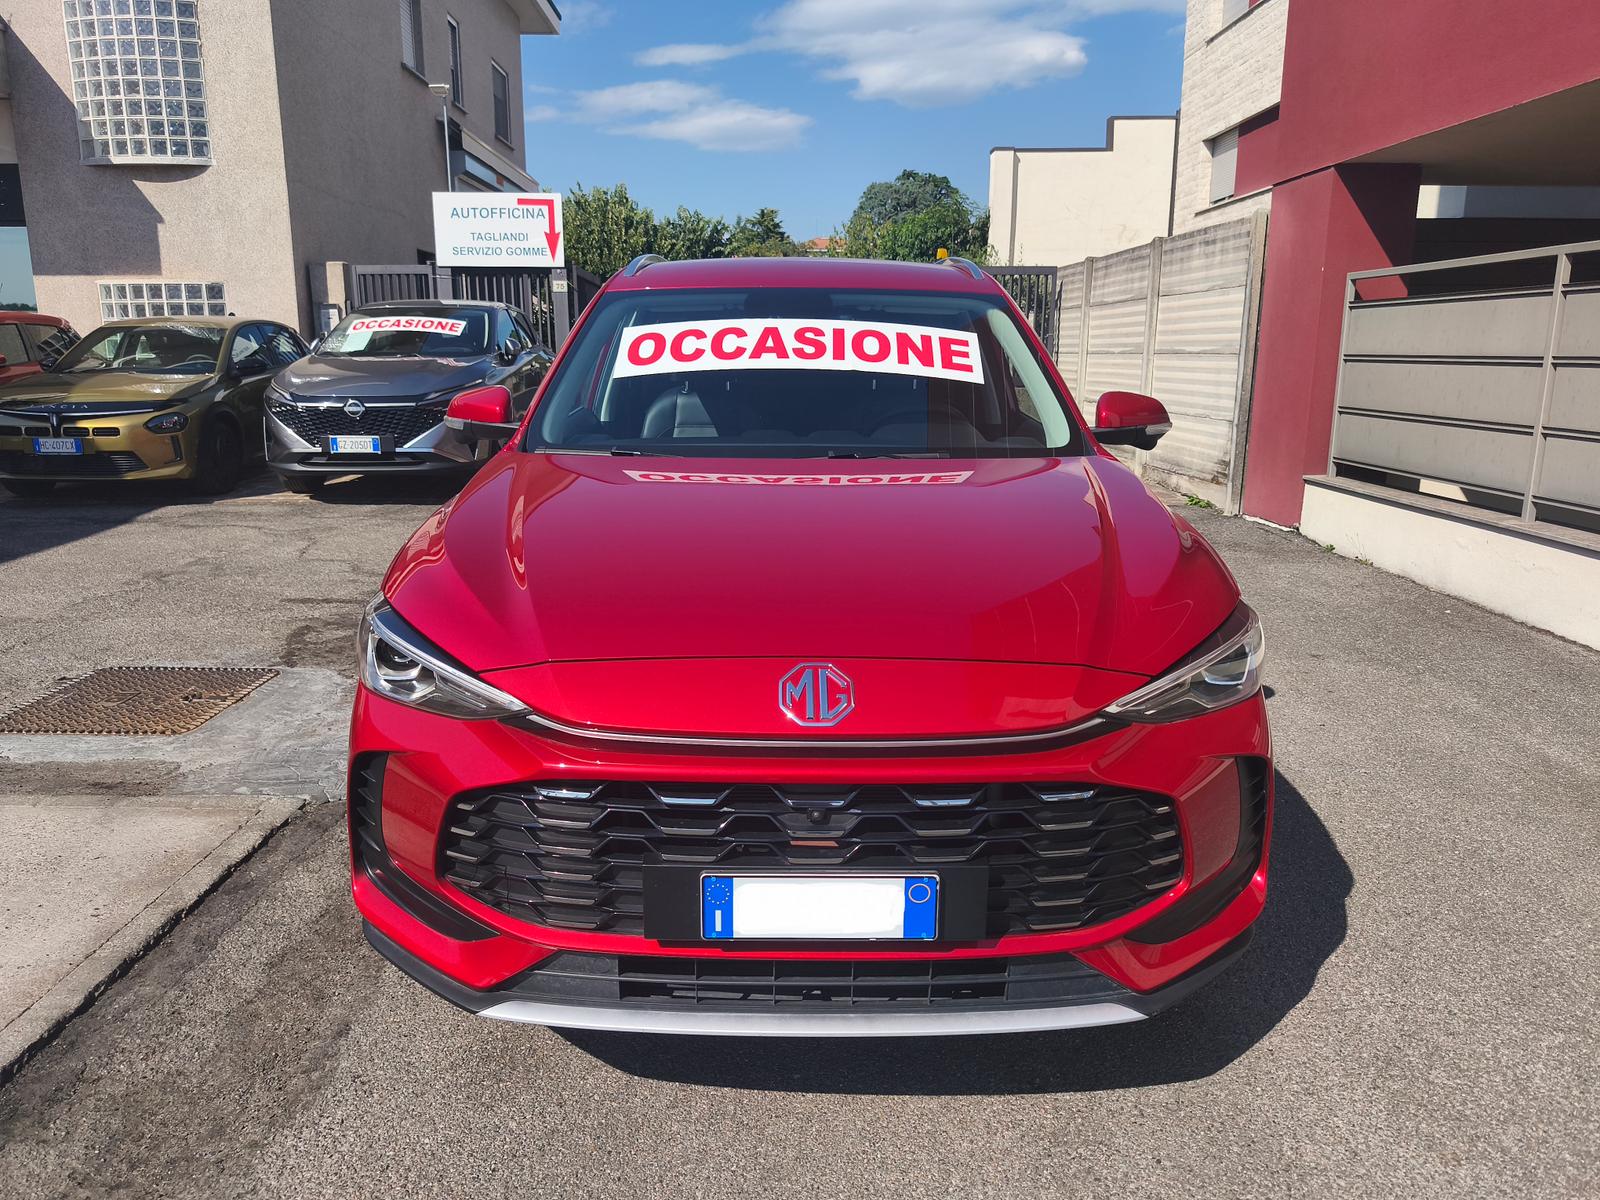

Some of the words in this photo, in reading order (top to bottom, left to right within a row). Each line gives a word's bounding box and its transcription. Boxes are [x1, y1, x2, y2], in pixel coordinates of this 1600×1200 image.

[450, 207, 546, 219] AUTOFFICINA
[470, 232, 529, 242] TAGLIANDI
[452, 246, 503, 256] SERVIZIO
[506, 247, 548, 257] GOMME
[352, 319, 463, 333] OCCASIONE
[627, 326, 974, 373] OCCASIONE
[786, 668, 848, 720] MG
